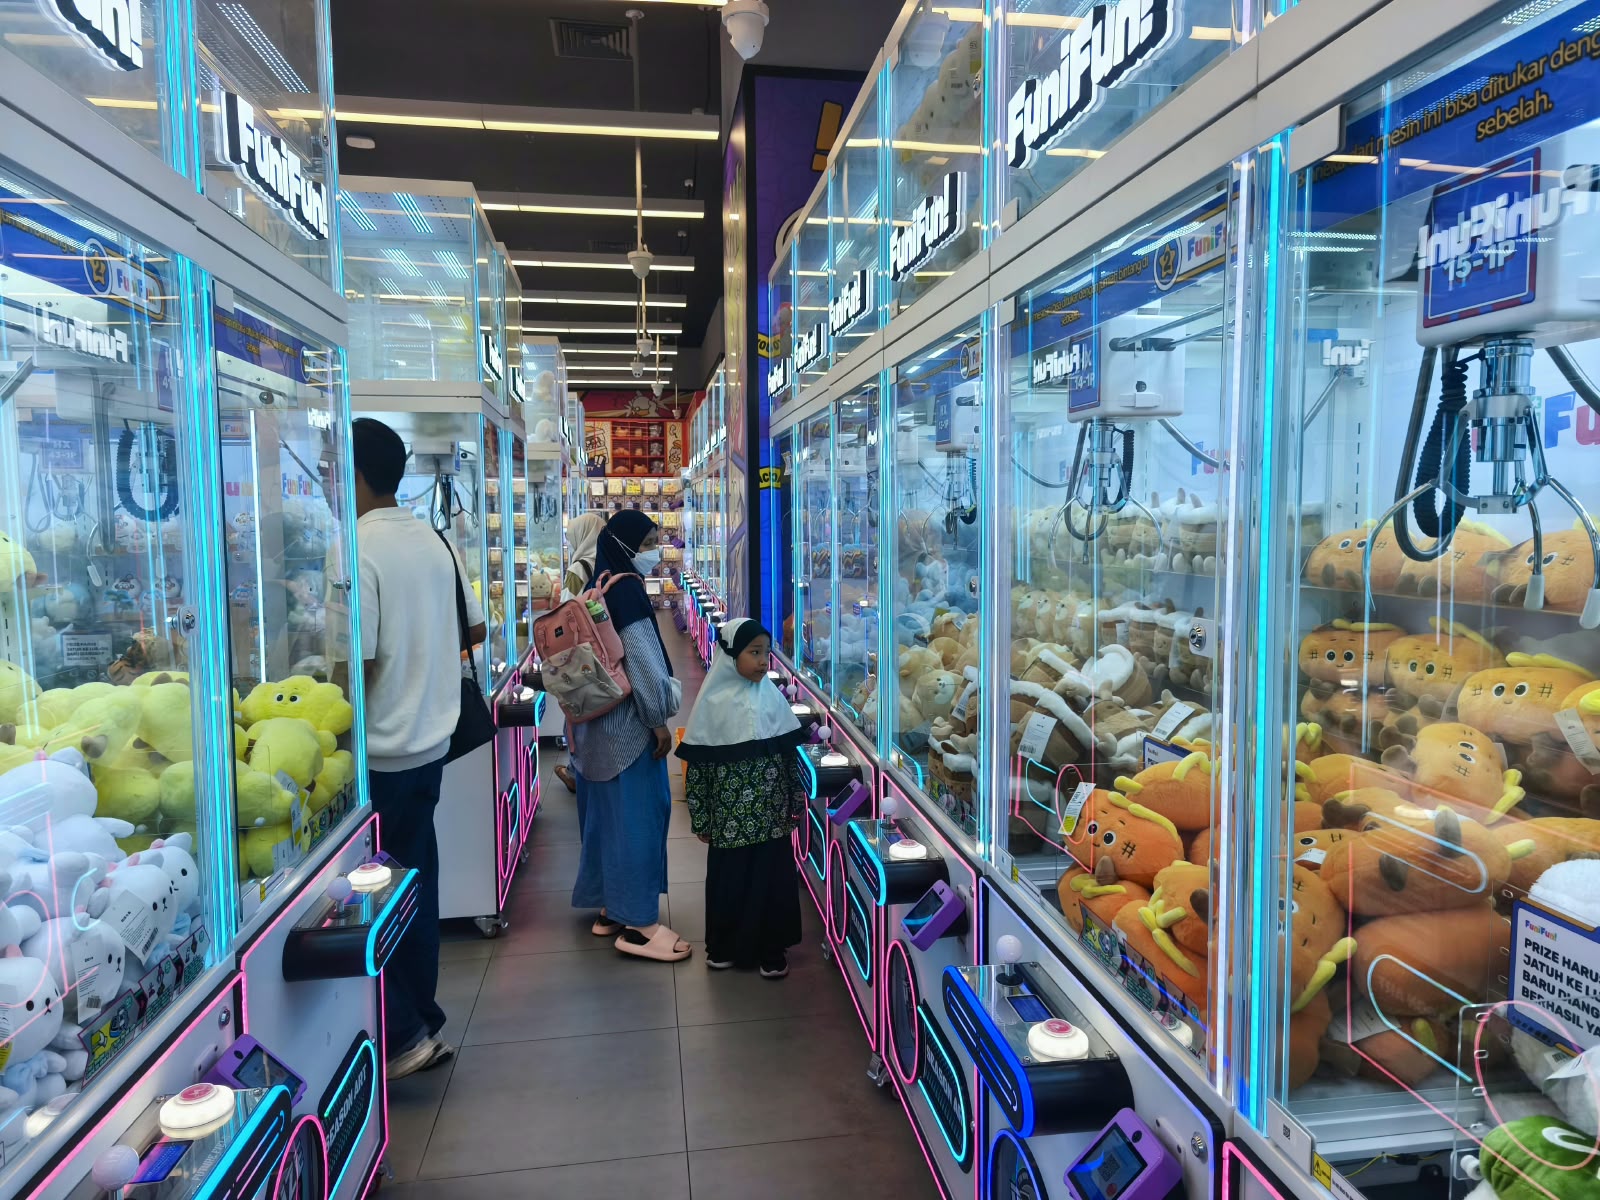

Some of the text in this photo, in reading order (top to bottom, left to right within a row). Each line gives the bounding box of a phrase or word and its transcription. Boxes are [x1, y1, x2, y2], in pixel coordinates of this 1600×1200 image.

[1445, 90, 1478, 121] bisa
[1480, 56, 1549, 103] ditukar
[1476, 89, 1554, 140] sebelah.
[237, 94, 329, 239] FuniFun!
[889, 172, 950, 282] FuniFun!
[1443, 239, 1517, 282] 15-1P
[1522, 969, 1556, 996] BARU
[1523, 953, 1564, 984] JATUH
[1566, 975, 1583, 993] KE
[1524, 937, 1600, 984] PRIZE HARU
[1521, 985, 1584, 1030] BERHASIL
[353, 1063, 368, 1099] ART
